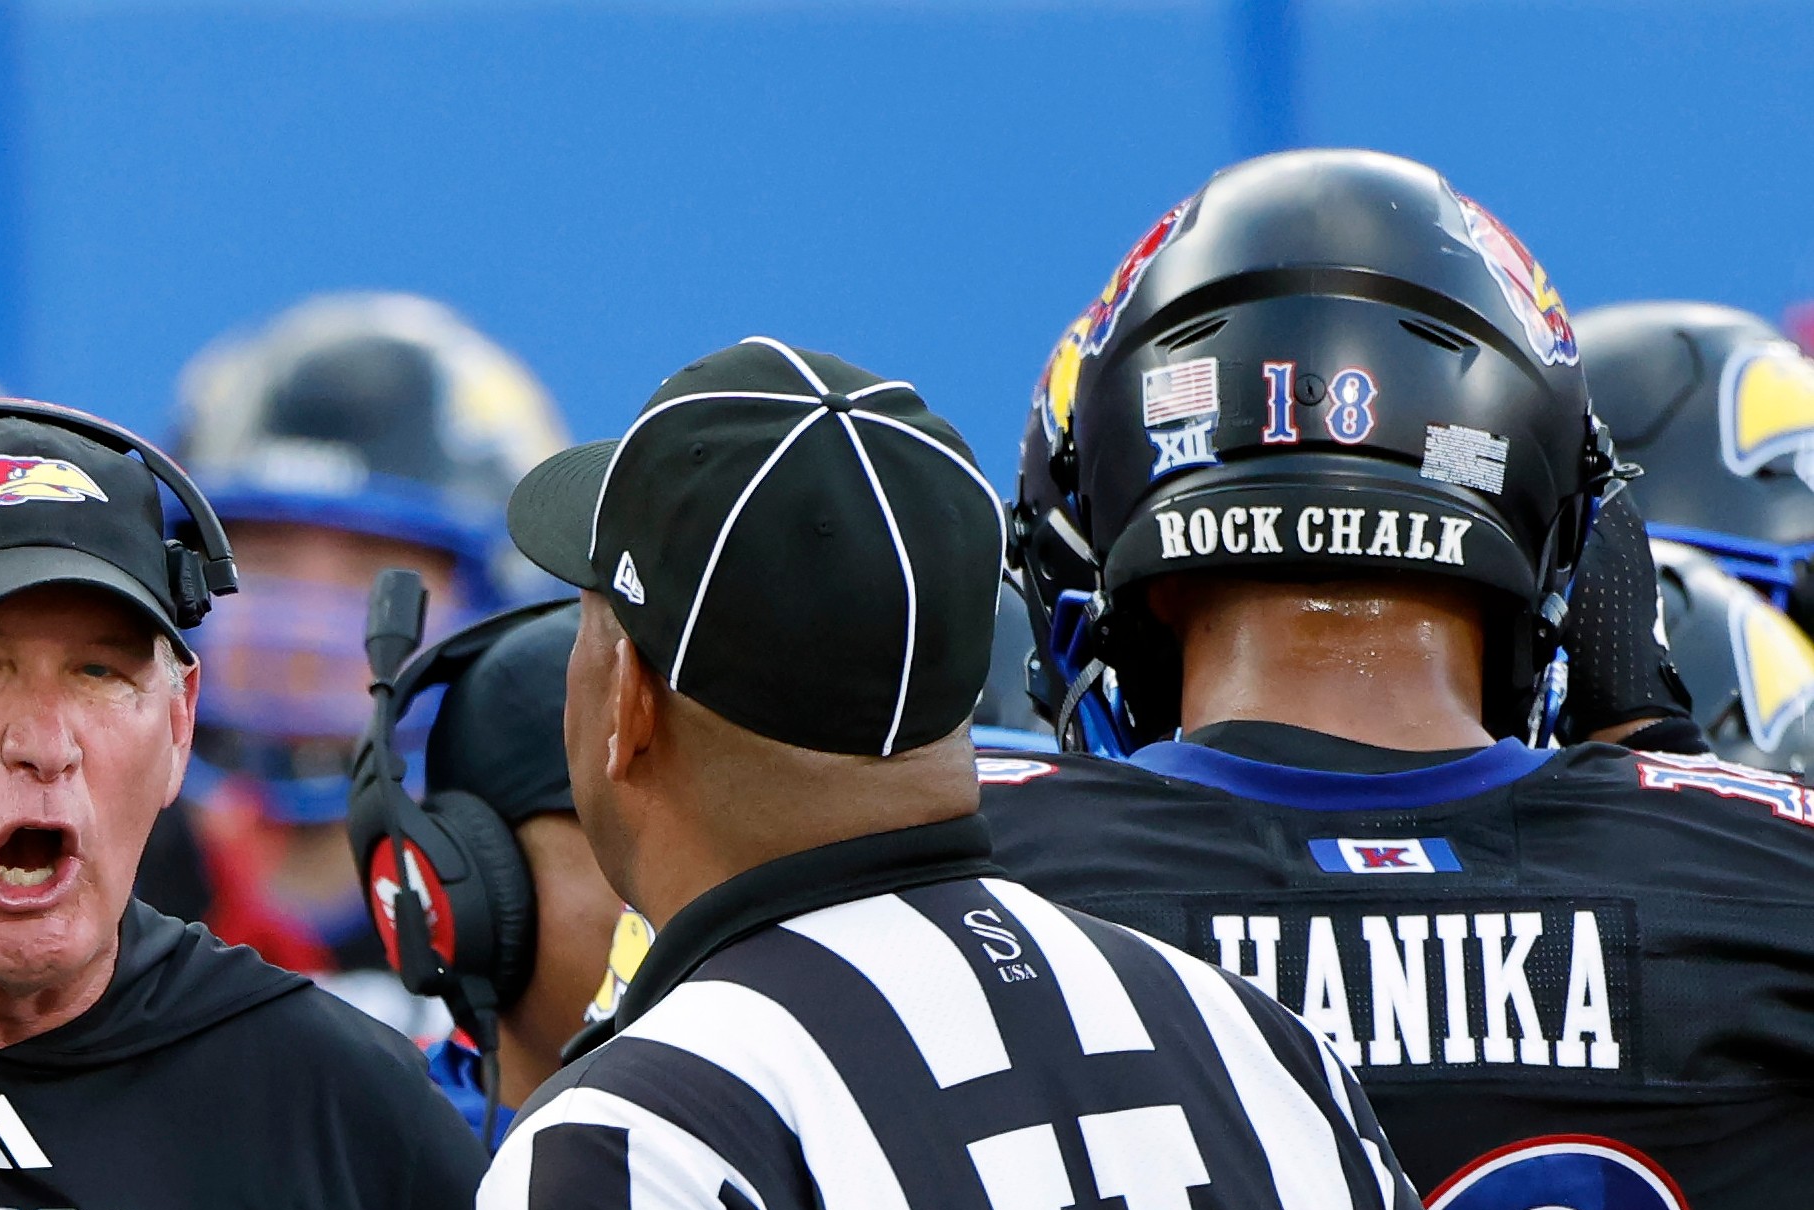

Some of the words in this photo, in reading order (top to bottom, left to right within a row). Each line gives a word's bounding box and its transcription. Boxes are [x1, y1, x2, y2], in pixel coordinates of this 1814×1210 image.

[1262, 360, 1378, 445] 18
[1155, 506, 1284, 559] ROCK
[1296, 506, 1473, 566] CHALK
[1353, 846, 1420, 869] K
[997, 963, 1038, 983] USA
[1211, 910, 1620, 1070] HANIKA
